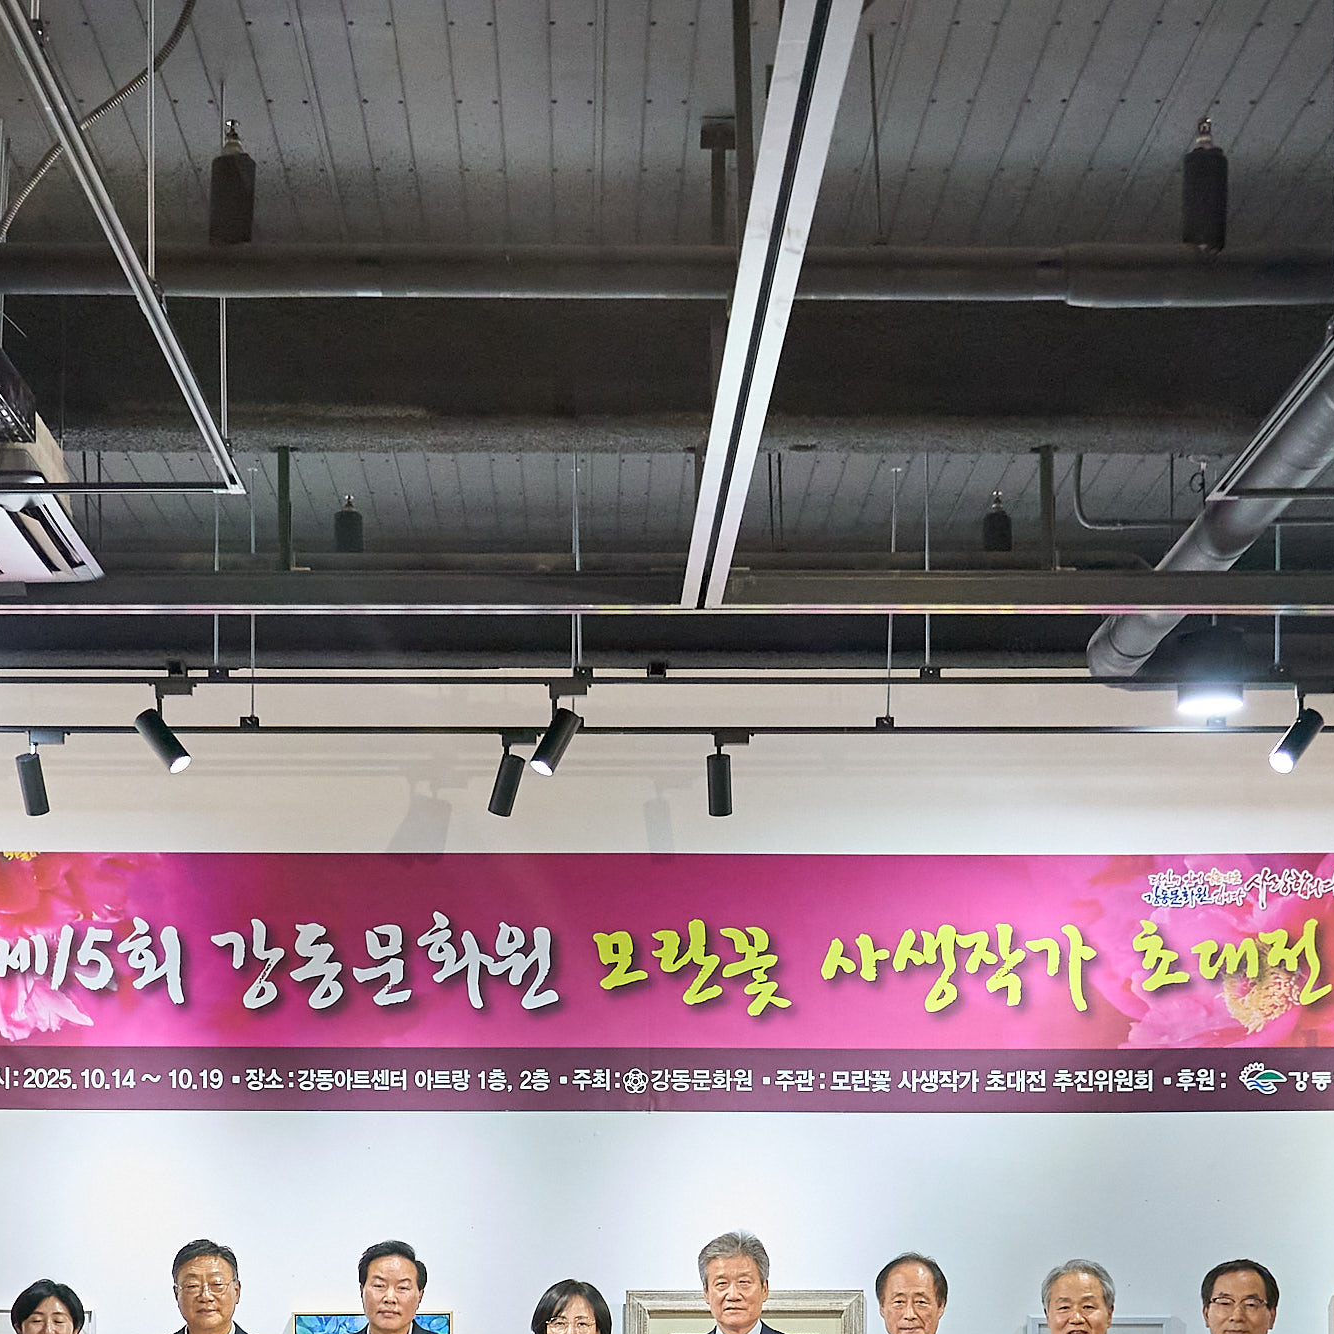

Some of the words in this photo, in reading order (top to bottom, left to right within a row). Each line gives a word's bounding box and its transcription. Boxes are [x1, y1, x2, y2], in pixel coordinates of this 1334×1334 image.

[1142, 886, 1213, 907] 강동문화원
[210, 911, 559, 1010] 강동문화원
[593, 919, 791, 1016] 모란꽃
[822, 919, 1096, 1011] 사생작가
[1133, 918, 1333, 1007] 초대전
[168, 1069, 224, 1090] 10.19
[297, 1069, 407, 1091] 강동아트센터
[414, 1069, 471, 1091] 아트랑
[477, 1069, 513, 1093] 1층,
[519, 1069, 551, 1091] 2층
[650, 1069, 753, 1092] 강동문화원
[830, 1070, 892, 1092] 모란꽃
[897, 1070, 980, 1093] 사생작가
[984, 1070, 1047, 1092] 초대전
[1052, 1070, 1153, 1092] 추진위원회
